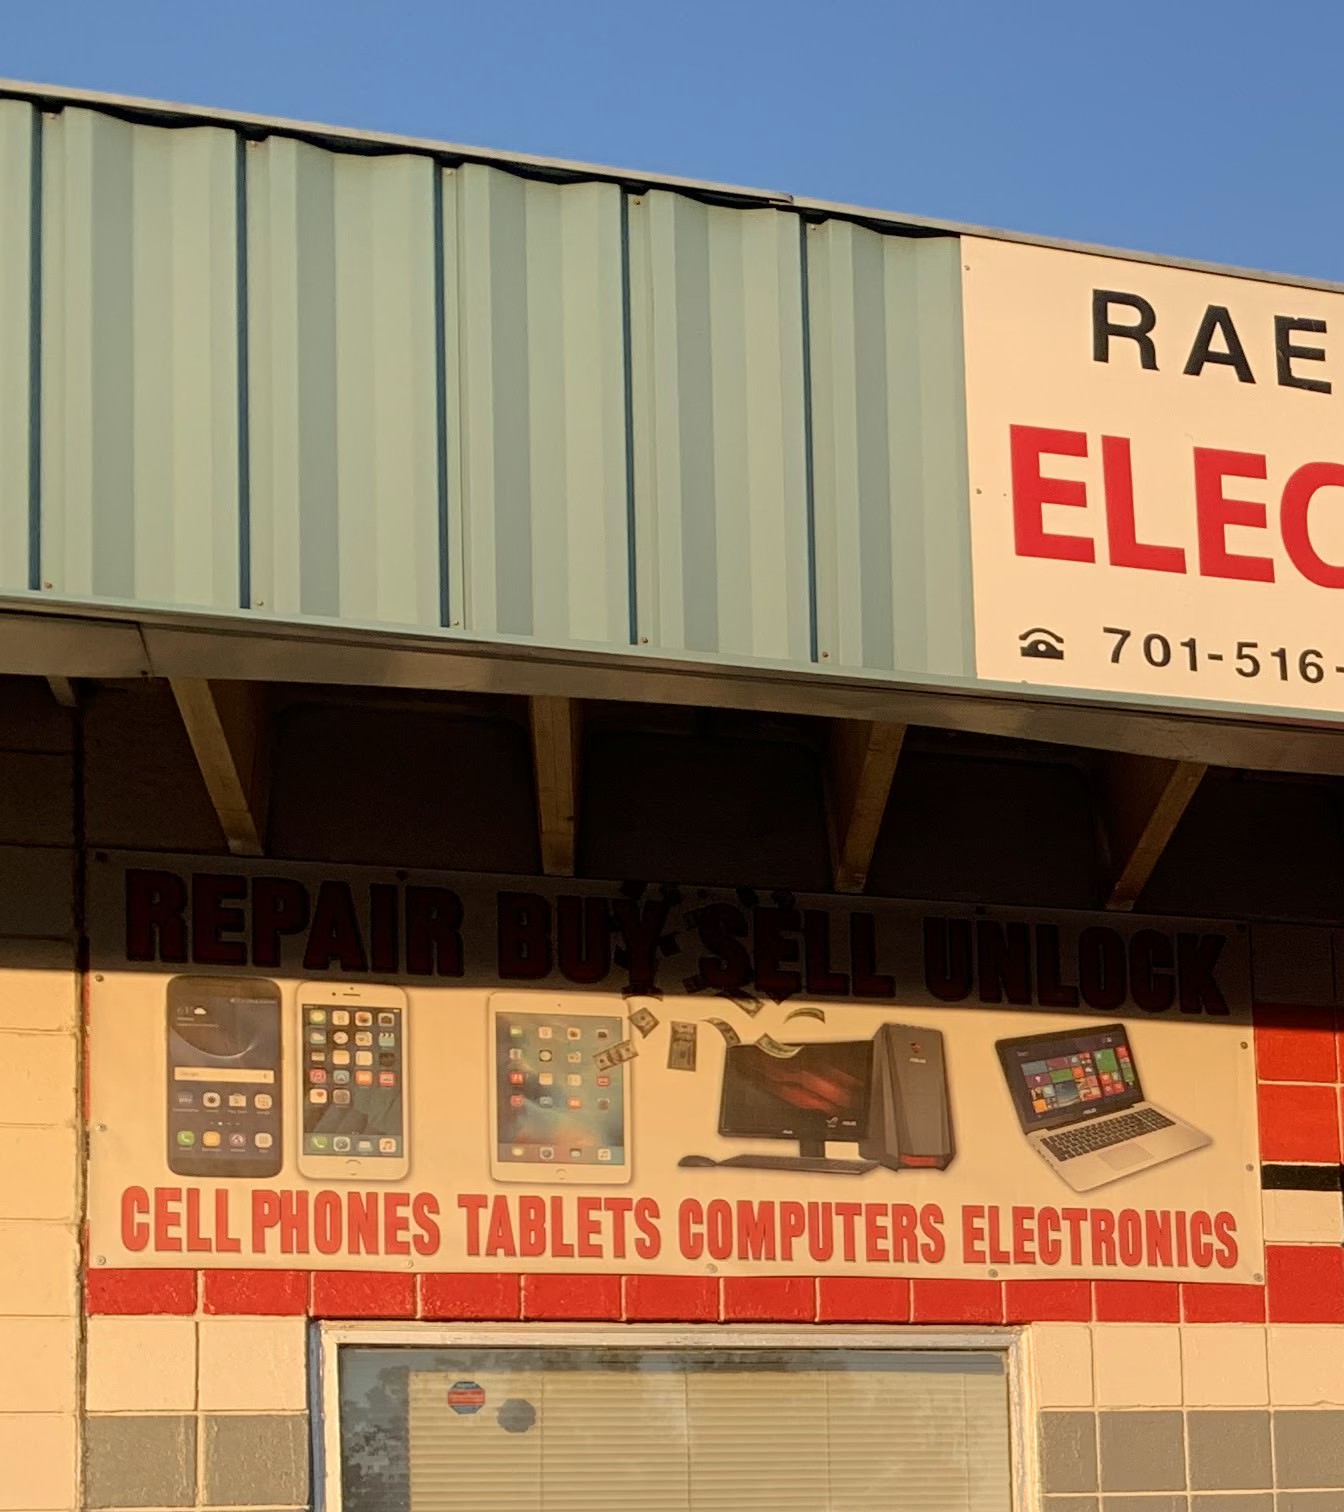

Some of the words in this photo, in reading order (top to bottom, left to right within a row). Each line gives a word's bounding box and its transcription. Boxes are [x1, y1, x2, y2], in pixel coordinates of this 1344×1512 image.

[125, 868, 464, 978] REPAIR
[496, 885, 664, 1000] BUY
[700, 902, 896, 1000] SELL
[923, 915, 1231, 1017] UNLOCK
[120, 1185, 242, 1255] CELL
[251, 1188, 441, 1256] PHONES
[457, 1193, 662, 1260] TABLETS
[678, 1198, 946, 1265] COMPUTERS
[961, 1204, 1240, 1269] ELECTRONICS
